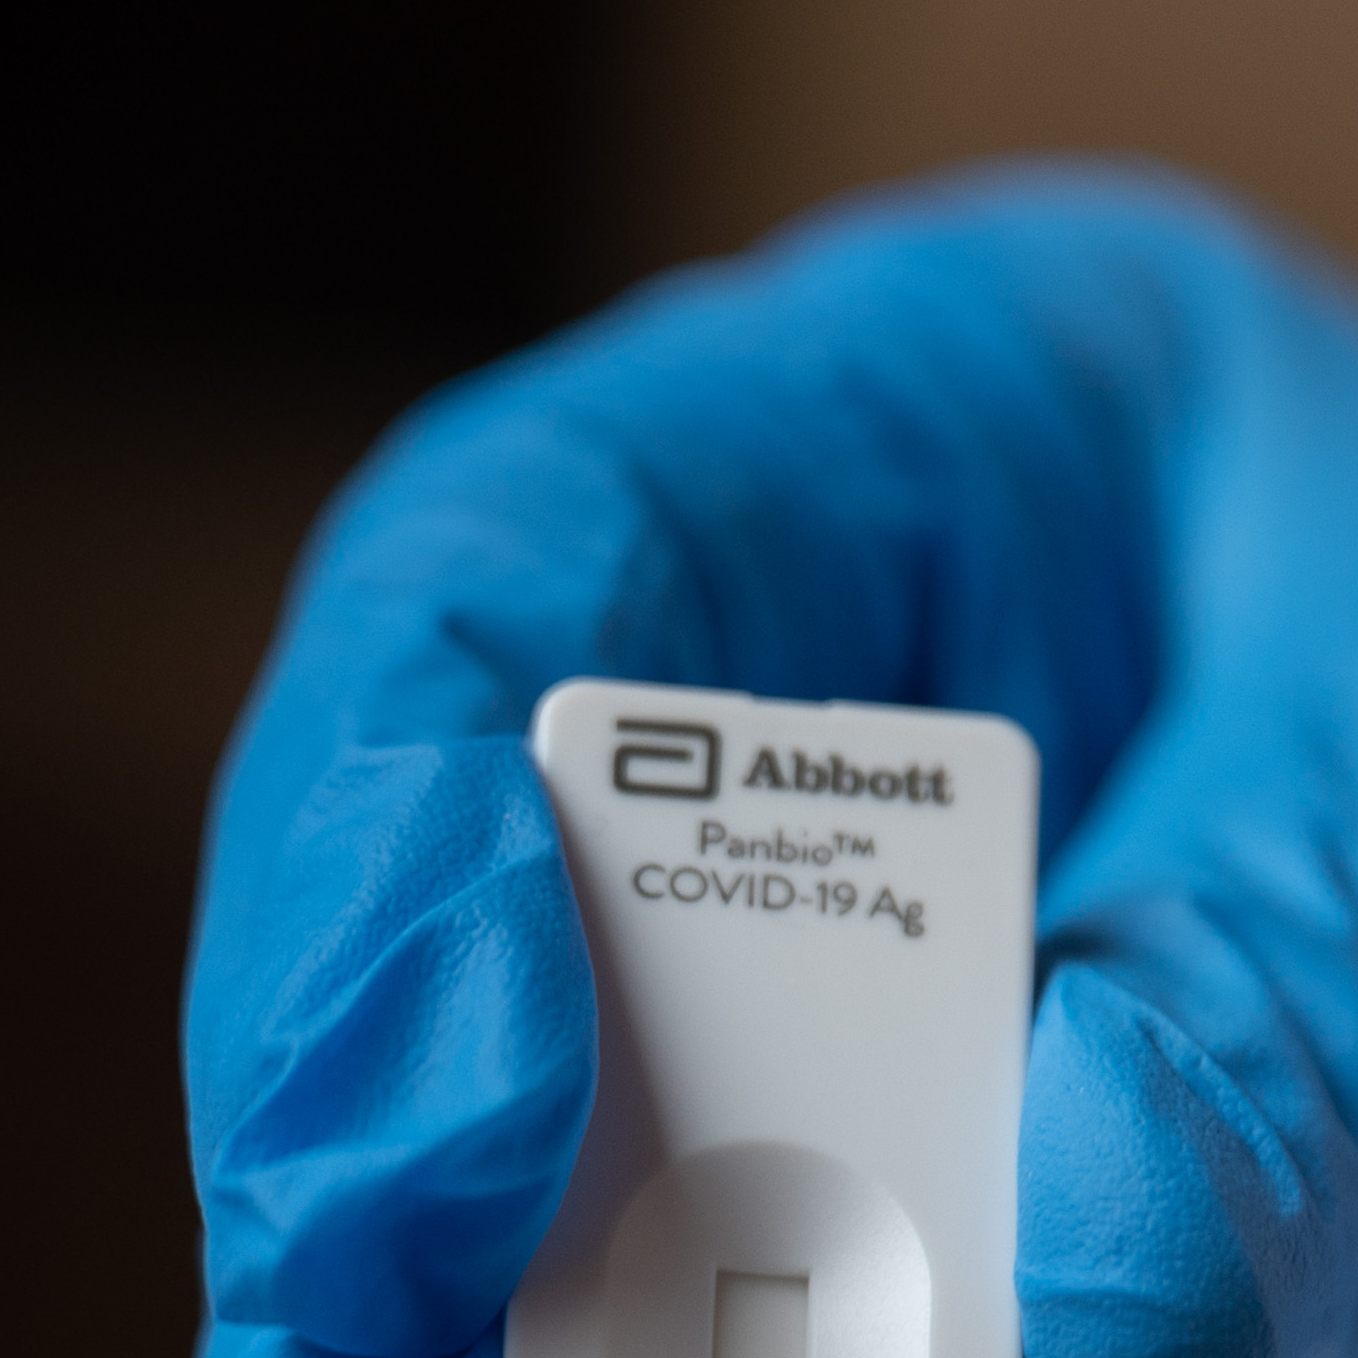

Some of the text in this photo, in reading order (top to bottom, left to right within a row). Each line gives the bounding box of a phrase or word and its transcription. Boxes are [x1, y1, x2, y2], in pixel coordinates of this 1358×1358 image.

[743, 747, 954, 805] Abbott
[632, 863, 926, 938] COVID-19 Ag
